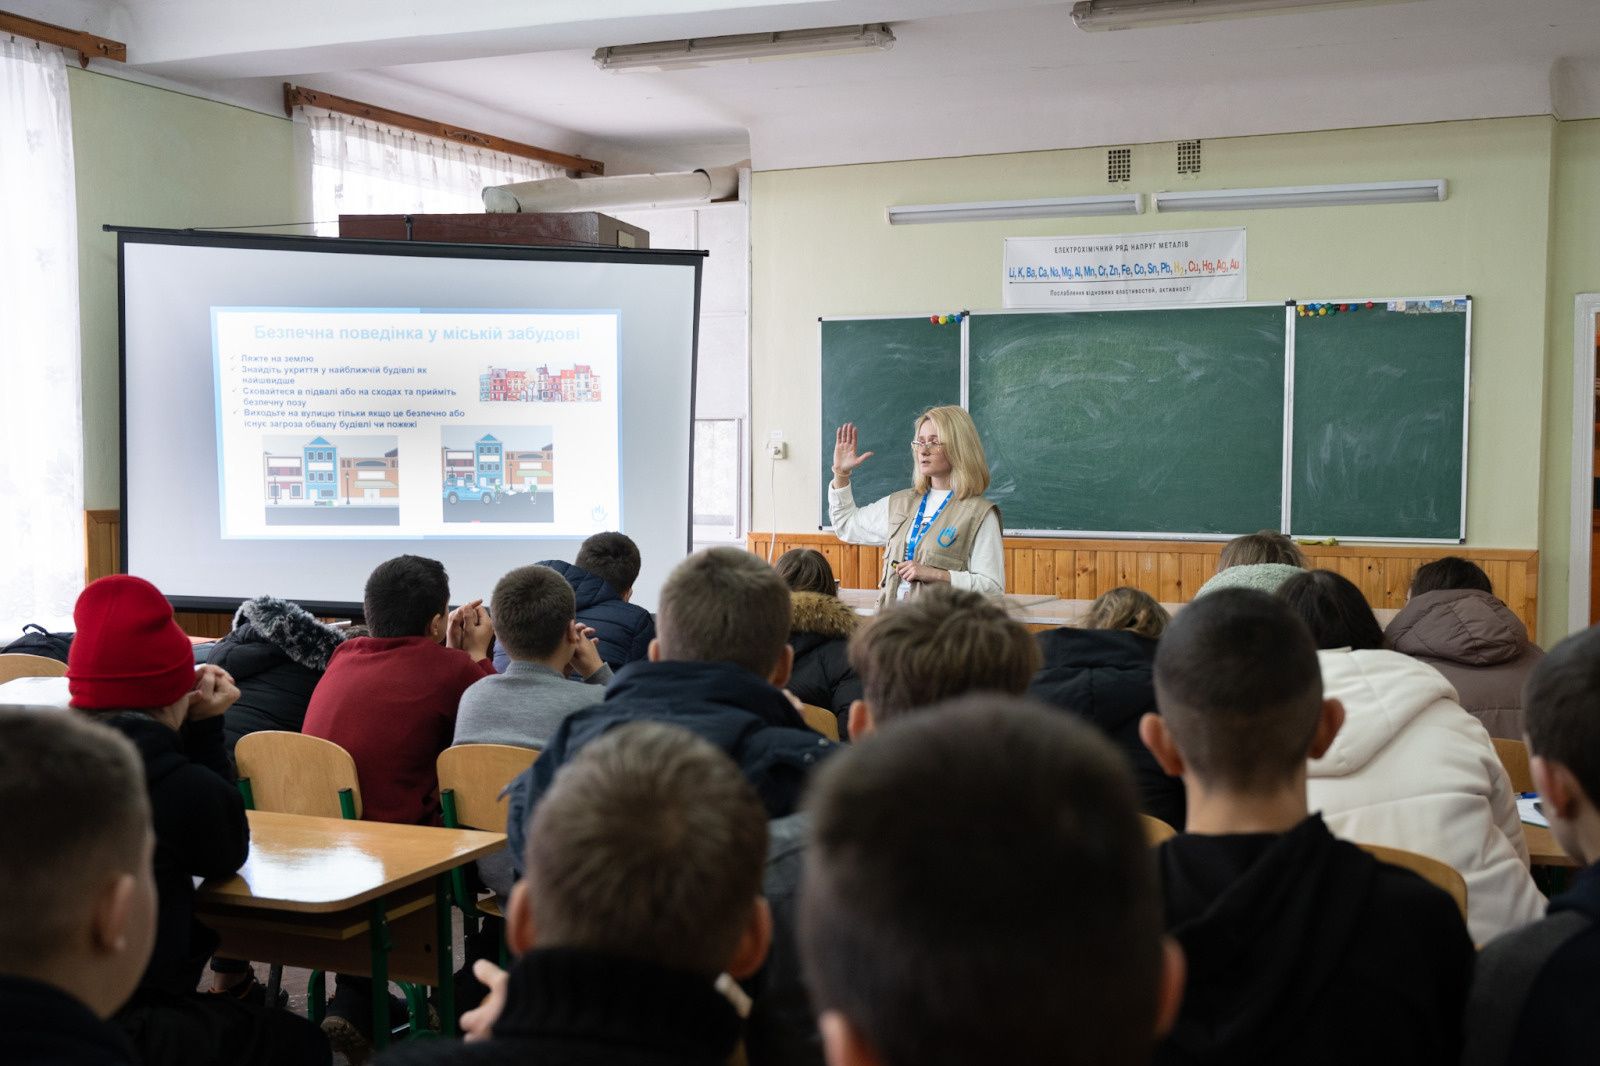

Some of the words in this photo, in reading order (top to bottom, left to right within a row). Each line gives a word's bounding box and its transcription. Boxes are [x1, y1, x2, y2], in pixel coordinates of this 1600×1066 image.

[1116, 244, 1129, 252] РЯД
[1130, 242, 1157, 251] НАПРУГ
[1159, 241, 1189, 249] МЕТАЛІВ
[254, 325, 335, 340] Безпечна
[339, 326, 423, 342] поведінка
[428, 328, 437, 342] у
[443, 327, 502, 340] міській
[507, 326, 581, 342] забудові
[241, 366, 282, 375] Знайдіть
[284, 367, 320, 375] укриття
[329, 366, 381, 374] найближчій
[383, 366, 415, 375] будівлі
[242, 377, 296, 385] найшвидше
[242, 387, 295, 396] Сховайтеся
[305, 387, 338, 397] підвалі
[340, 387, 357, 396] або
[371, 389, 402, 397] сходах
[416, 387, 457, 397] прийміть
[243, 398, 284, 408] безпечну
[286, 400, 307, 408] позу
[244, 409, 286, 418] Виходьте
[301, 411, 335, 419] вулицю
[338, 409, 366, 418] тільки
[368, 411, 391, 419] якщо
[393, 411, 404, 419] це
[405, 409, 447, 418] безпечно
[449, 409, 466, 418] або
[244, 420, 267, 429] існує
[269, 421, 303, 429] загроза
[305, 420, 337, 430] обвалу
[339, 420, 372, 430] будівлі
[386, 421, 418, 429] пожежі
